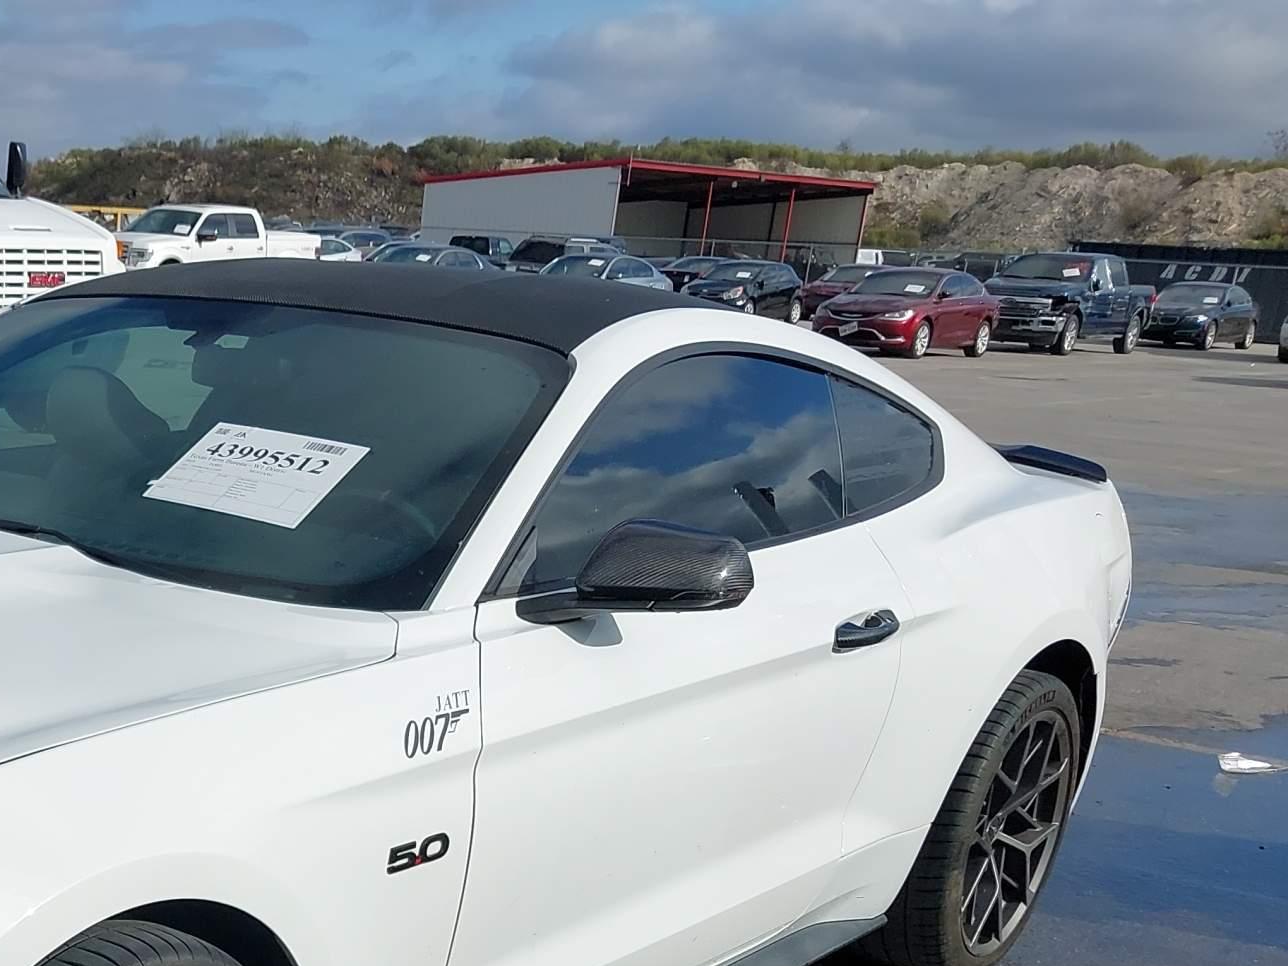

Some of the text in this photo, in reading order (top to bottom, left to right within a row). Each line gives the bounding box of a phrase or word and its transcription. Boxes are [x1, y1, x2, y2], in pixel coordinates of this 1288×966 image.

[205, 441, 330, 475] 43995512
[435, 689, 470, 713] JATT
[404, 712, 450, 759] 007
[386, 832, 450, 875] 5.0
